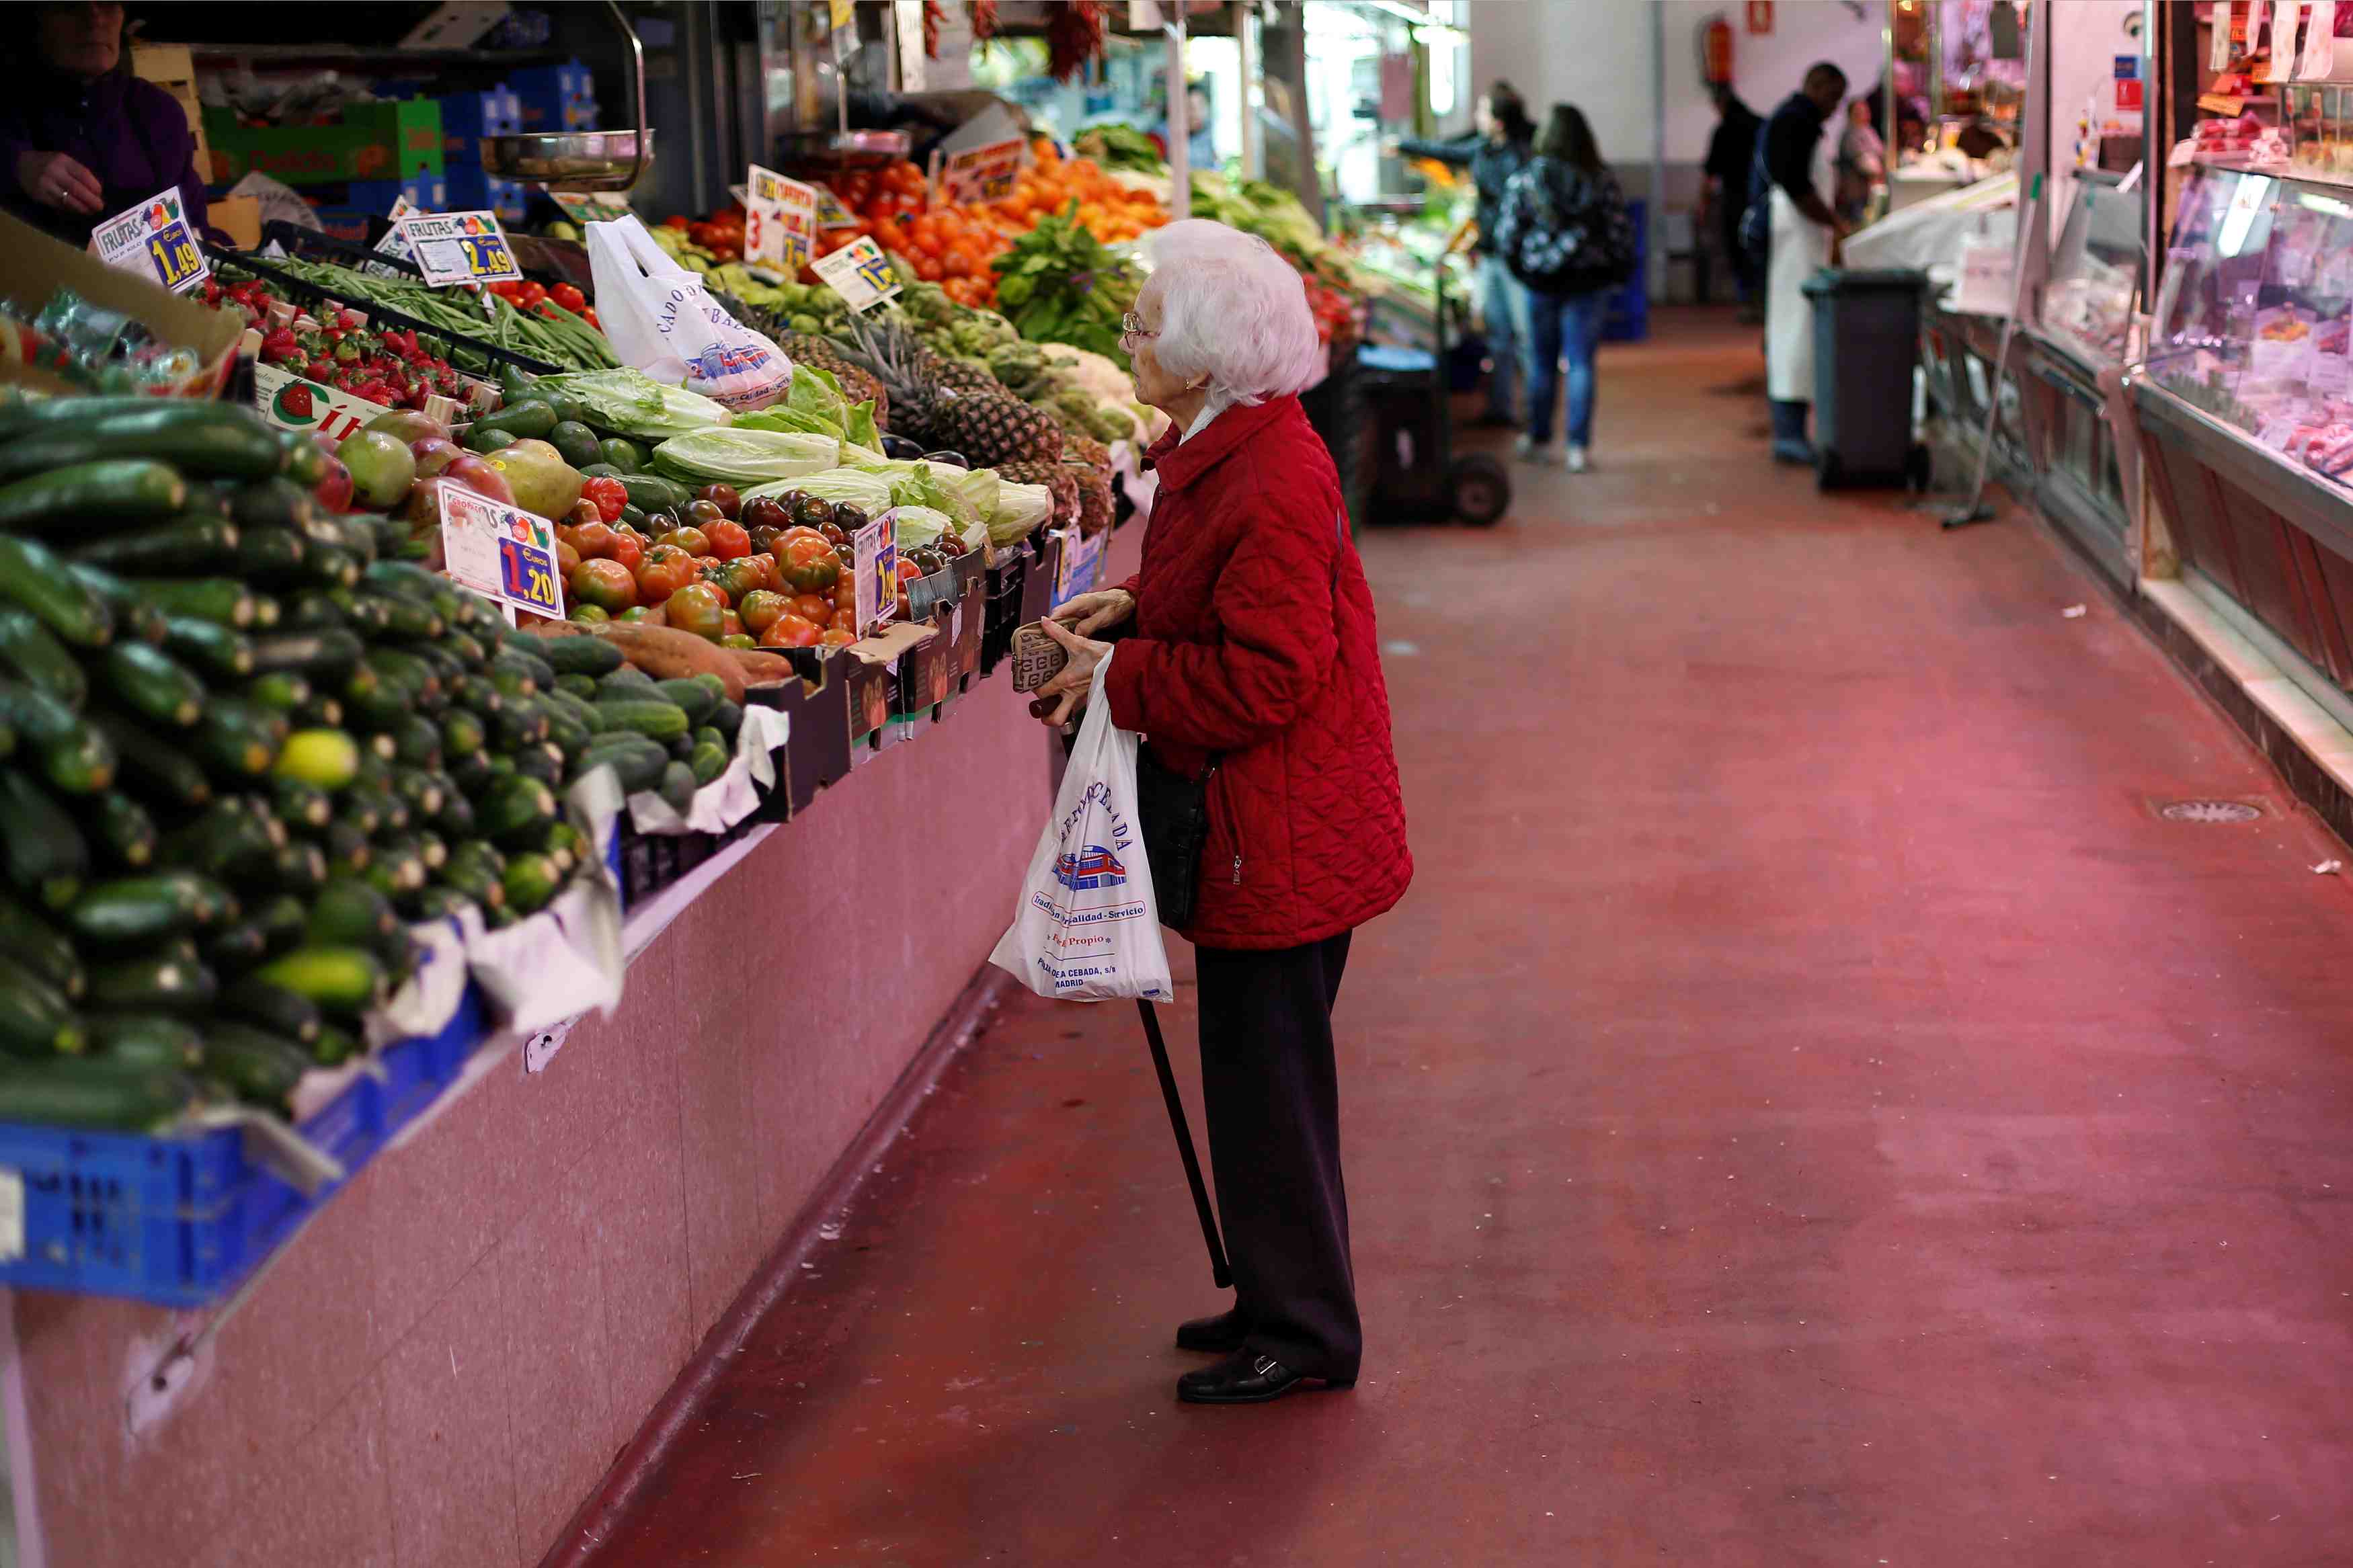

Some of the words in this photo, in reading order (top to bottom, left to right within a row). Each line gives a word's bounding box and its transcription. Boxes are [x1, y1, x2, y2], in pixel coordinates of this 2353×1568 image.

[102, 218, 141, 255] FRUTAS
[408, 221, 452, 237] FRUTAS
[152, 239, 200, 285] 1,49
[461, 240, 512, 275] 2,49
[502, 544, 555, 606] 1,20
[1070, 912, 1103, 925] alidad
[1069, 935, 1103, 946] Propio
[1068, 967, 1102, 978] CEBADA,
